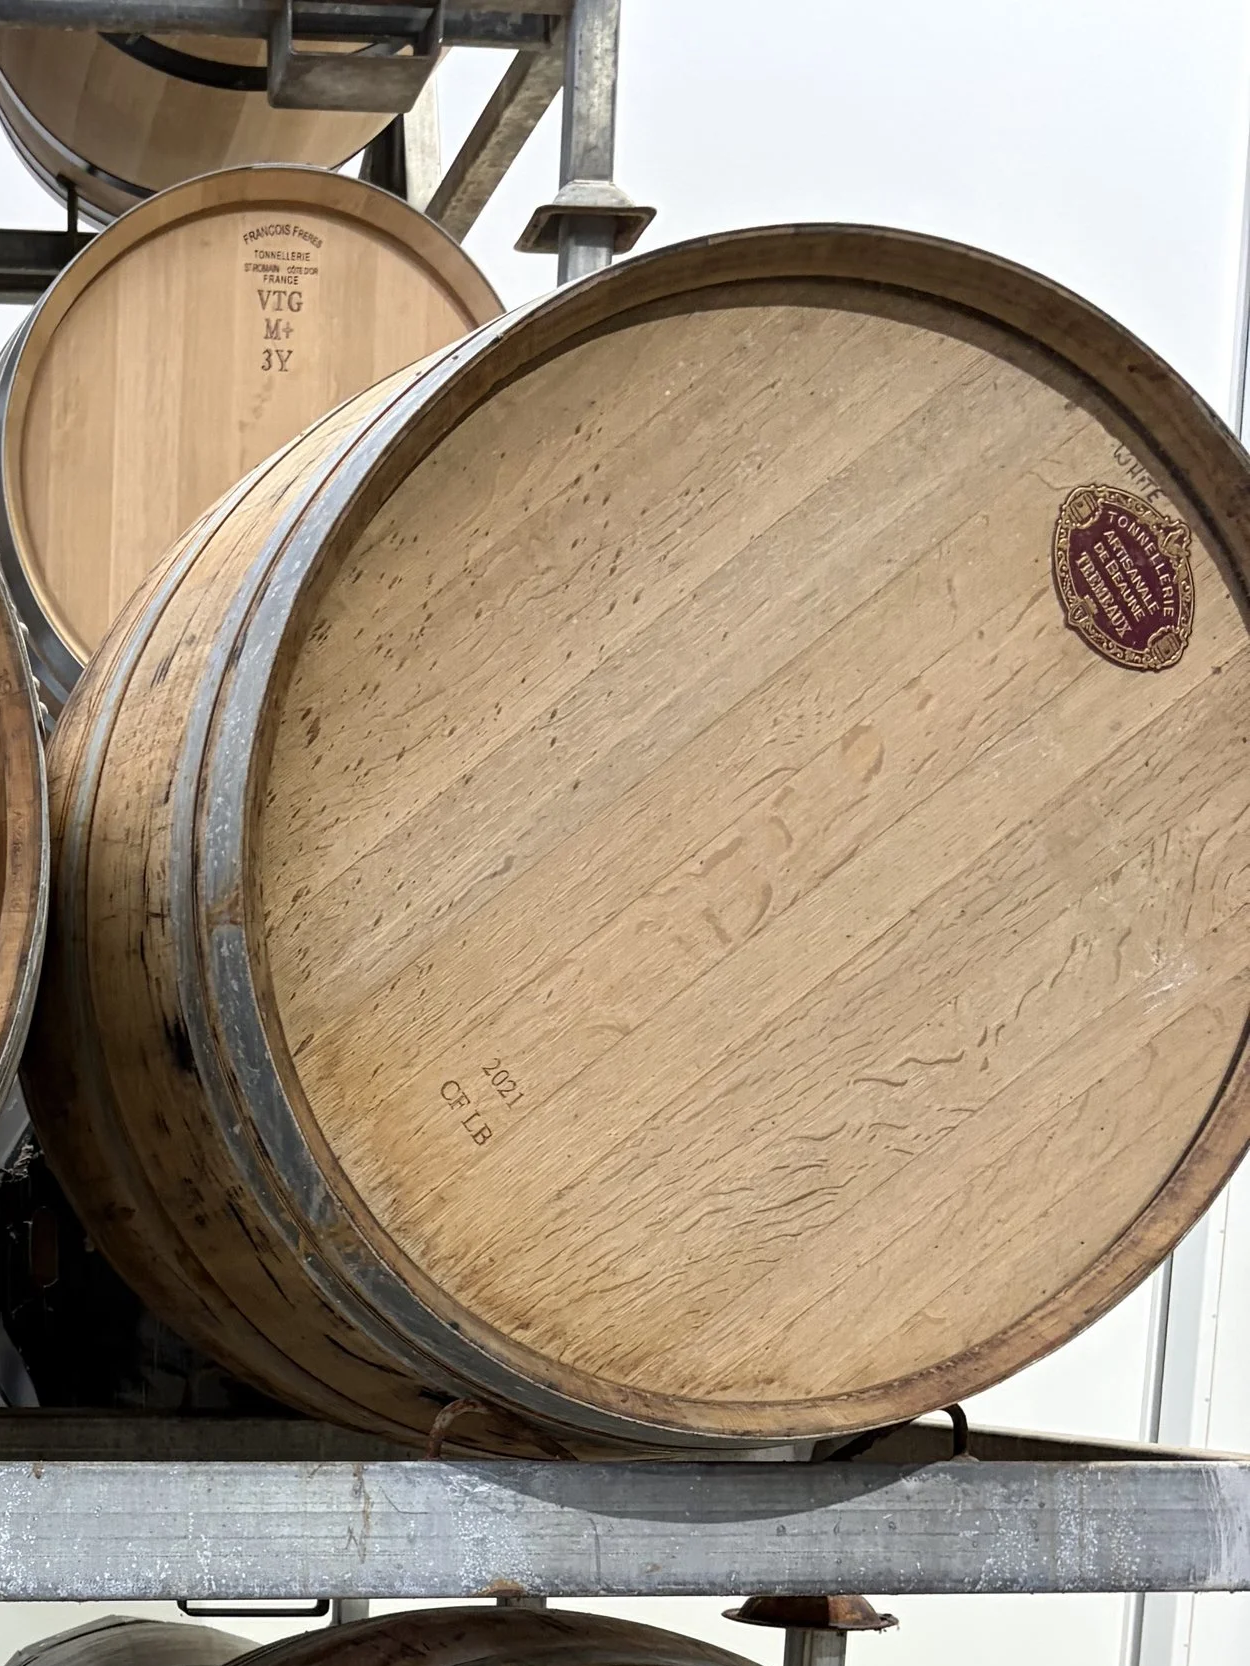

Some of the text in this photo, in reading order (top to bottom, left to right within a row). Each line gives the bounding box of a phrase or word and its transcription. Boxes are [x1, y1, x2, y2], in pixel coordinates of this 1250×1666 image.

[254, 250, 310, 261] TONNELLERIE
[253, 263, 279, 273] ROMAIN
[263, 274, 299, 285] FRANCE
[257, 289, 304, 312] VTG
[263, 318, 294, 340] M+
[261, 349, 293, 372] 3Y
[1104, 530, 1160, 615] ARTISANALE
[1107, 511, 1174, 617] TONNELLERIE
[1094, 542, 1146, 623] DE BEAUNE
[1075, 551, 1132, 638] TREMEAUX
[481, 1057, 524, 1109] 2021
